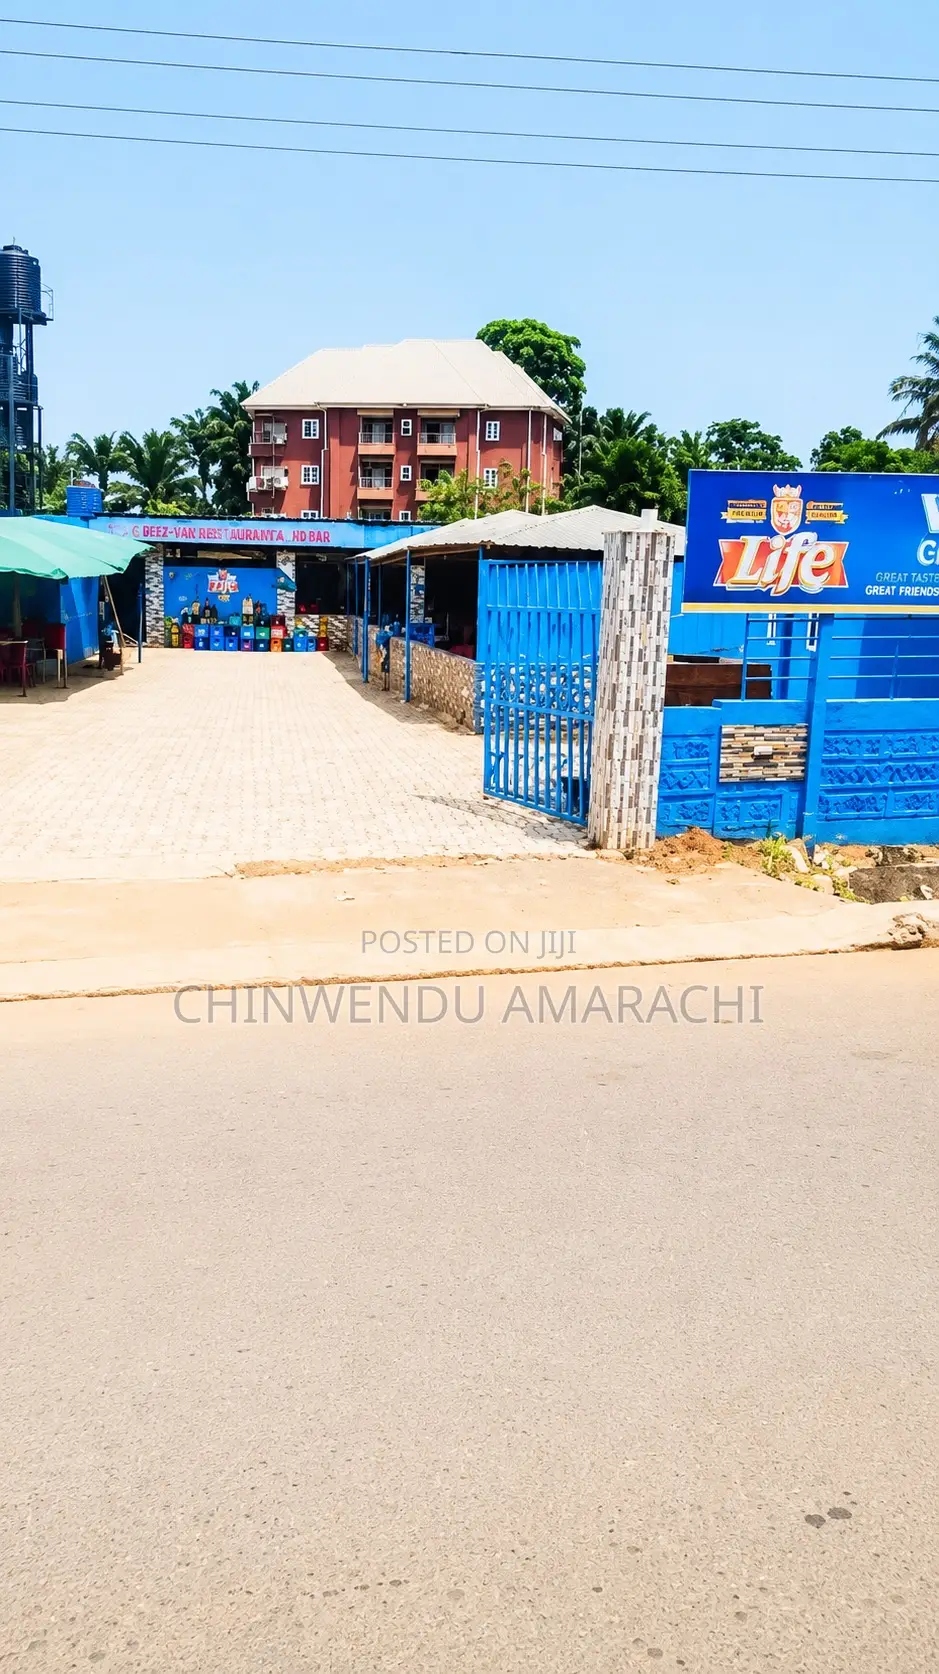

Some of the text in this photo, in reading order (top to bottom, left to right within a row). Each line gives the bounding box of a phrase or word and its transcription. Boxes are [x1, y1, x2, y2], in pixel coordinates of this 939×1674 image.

[309, 530, 331, 543] BAR
[726, 532, 835, 596] Life
[876, 572, 908, 583] GREAT
[865, 585, 896, 596] GREAT
